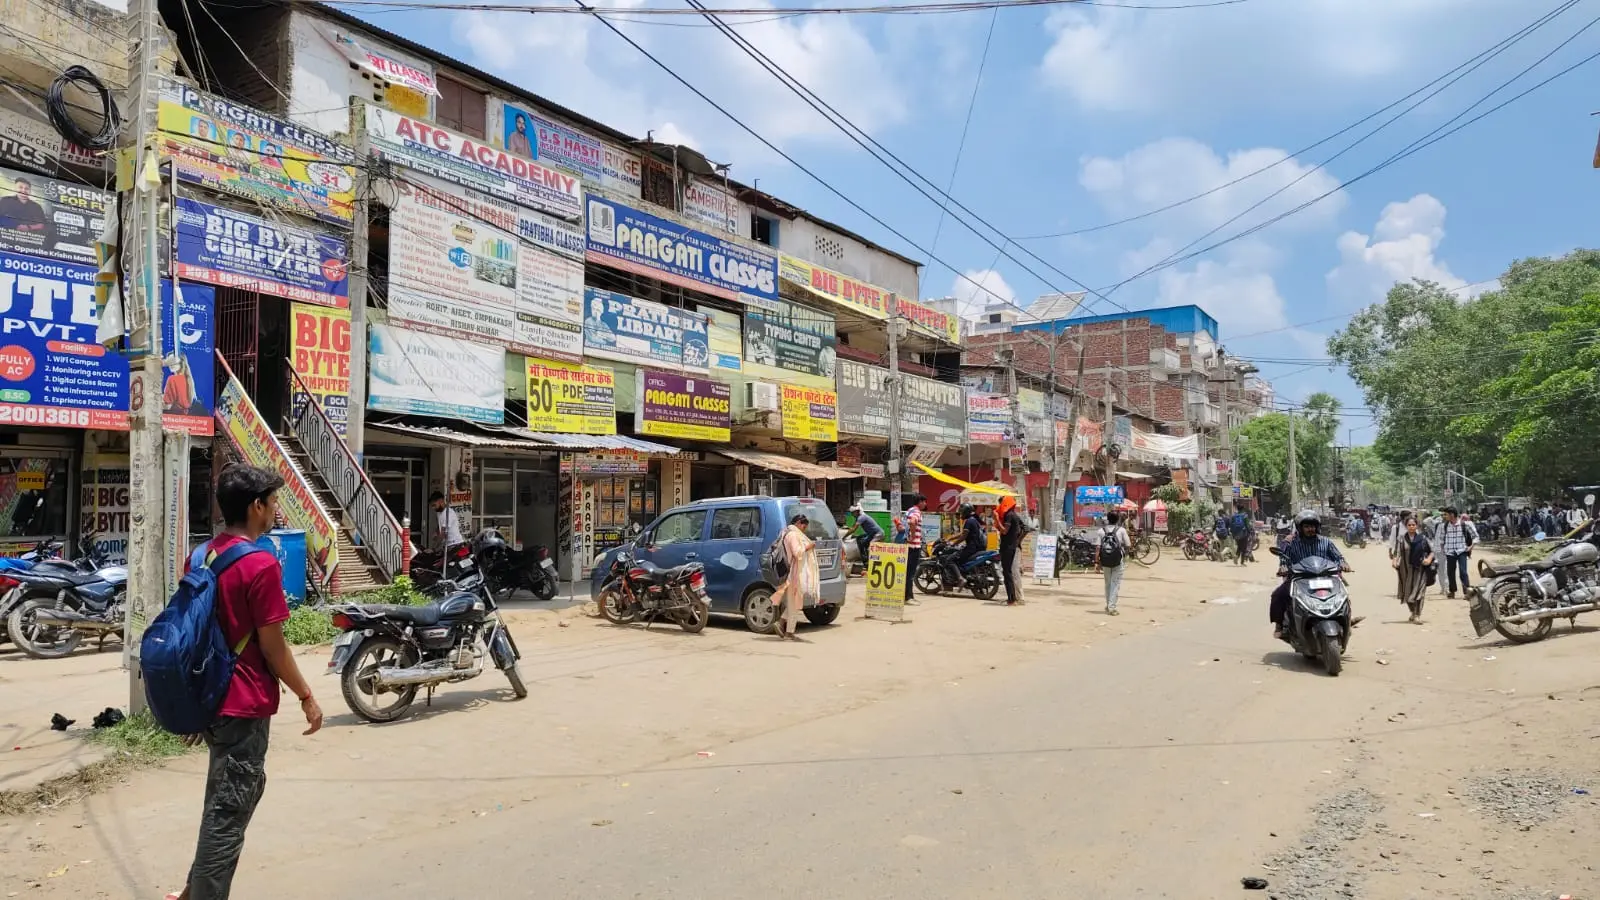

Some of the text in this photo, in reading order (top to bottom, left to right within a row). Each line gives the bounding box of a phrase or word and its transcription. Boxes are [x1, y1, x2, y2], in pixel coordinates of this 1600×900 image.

[185, 90, 276, 133] PAGATI
[282, 126, 356, 161] CLASSES
[396, 117, 452, 151] ATC
[460, 140, 575, 194] ACADEMY
[57, 185, 117, 205] SCIENC
[60, 195, 87, 209] FOR
[91, 201, 105, 212] FU
[206, 213, 249, 242] BIG
[258, 224, 321, 260] BYTE
[520, 218, 585, 255] PRATIBHA CLASSES
[700, 241, 721, 253] FACULTY
[4, 258, 64, 277] 9001:2015
[204, 234, 321, 276] COMPUTER
[617, 223, 703, 273] PRAGATI
[709, 253, 775, 294] CLASSES
[811, 267, 949, 331] BIG BYTE CMPUTER
[3, 318, 87, 342] PVT.
[608, 300, 706, 335] PRATIBHA
[617, 316, 683, 342] LIBRARY
[791, 305, 836, 339] COMPUTER
[296, 312, 350, 353] BIG
[764, 323, 822, 350] TYPING CENTER
[0, 355, 32, 376] FULLY AC
[52, 366, 92, 378] Monitoring
[102, 370, 121, 379] CCTV
[69, 357, 100, 368] Campus
[296, 350, 350, 379] BYTE
[52, 376, 76, 386] Digital
[77, 378, 97, 387] Class
[97, 380, 118, 388] Room
[105, 390, 118, 398] Lab
[529, 378, 552, 413] 50
[562, 385, 583, 400] PDF
[842, 362, 865, 389] BIG
[904, 376, 961, 408] COMPUTER
[330, 395, 346, 406] DCA
[645, 389, 729, 414] PRAGATI CLASSES
[784, 401, 793, 412] 50
[19, 476, 44, 484] OFFICE
[237, 398, 329, 538] BIG BYTE COMPUTER
[97, 487, 130, 507] BIG
[584, 490, 592, 566] PRAGATI
[869, 560, 897, 591] 50
